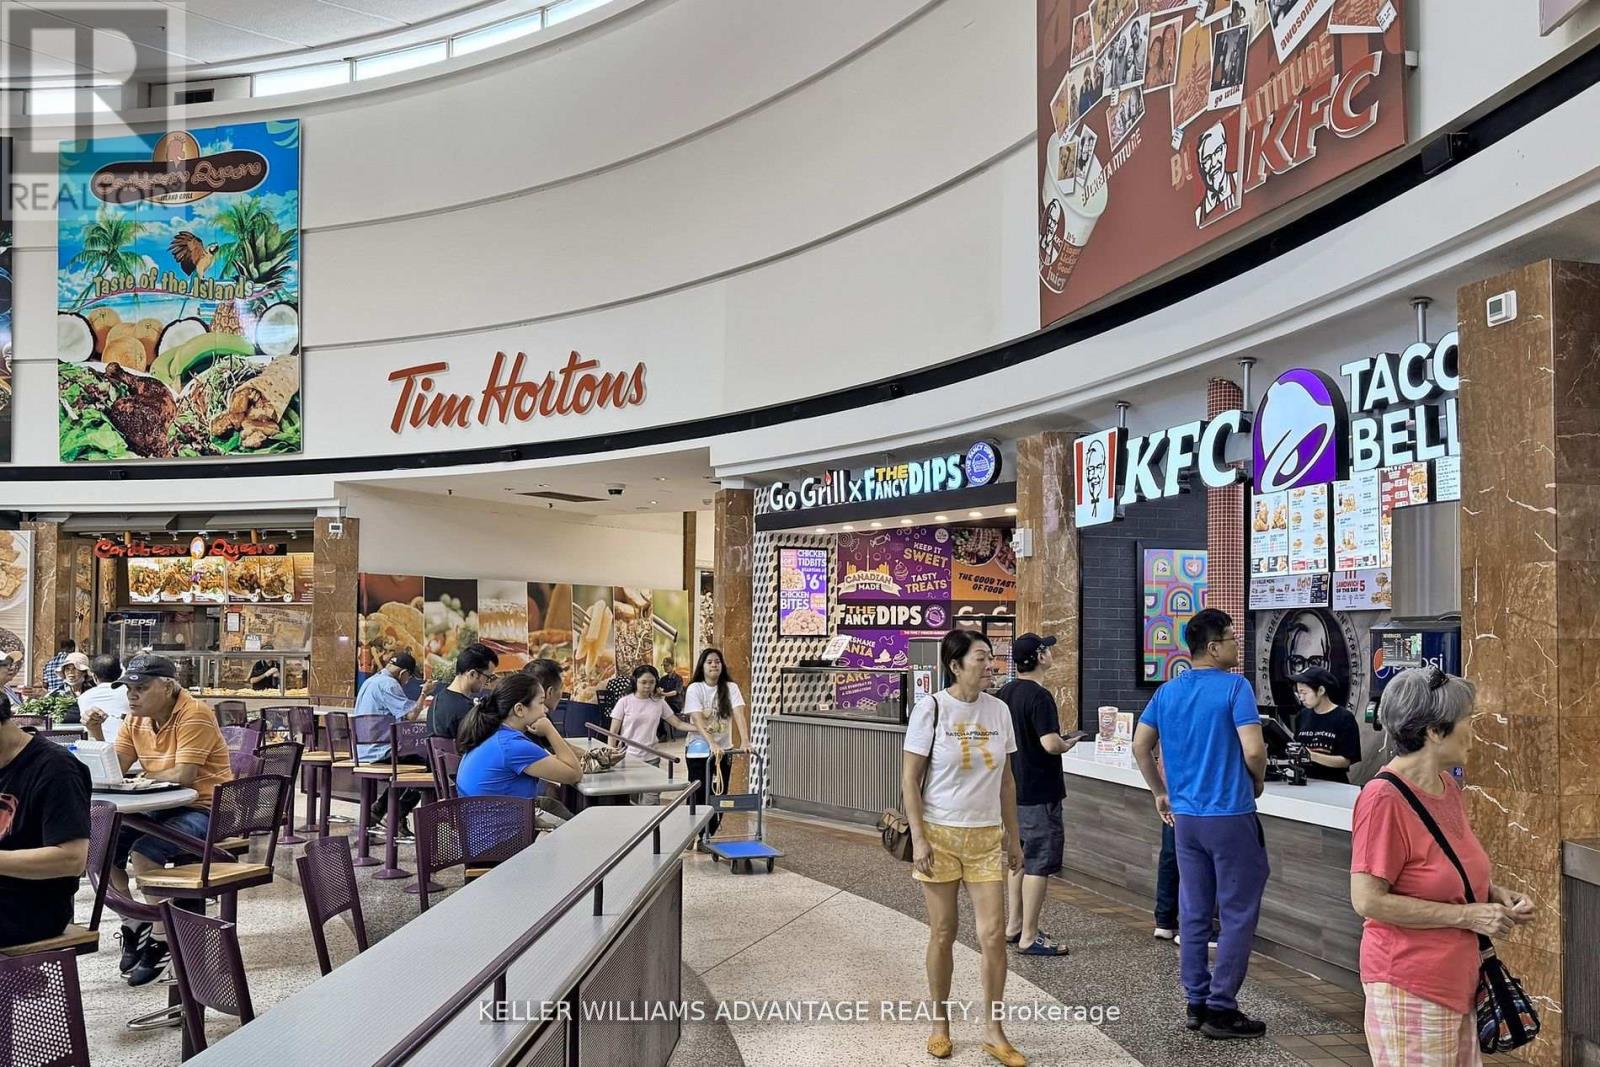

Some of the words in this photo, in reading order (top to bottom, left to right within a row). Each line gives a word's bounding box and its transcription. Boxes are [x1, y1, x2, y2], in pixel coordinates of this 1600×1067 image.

[1244, 51, 1383, 193] KFC
[191, 160, 262, 188] Queen
[93, 275, 135, 297] Taste
[139, 269, 158, 290] of
[161, 270, 188, 294] the
[192, 276, 254, 300] Islands
[1341, 331, 1459, 413] TACO
[388, 361, 474, 434] Tim
[478, 350, 646, 425] Hortons
[1119, 410, 1241, 505] KFC
[875, 464, 909, 481] THE
[908, 453, 962, 495] DIPS
[801, 470, 846, 507] Grill
[864, 467, 908, 501] FANCY
[770, 482, 796, 511] Go
[209, 538, 278, 563] Queen
[903, 548, 948, 568] SWEET
[913, 541, 933, 551] KEEP
[934, 546, 943, 554] IT
[797, 558, 827, 567] TIDBITS
[845, 572, 893, 585] CANADIAN
[905, 579, 948, 593] TREATS
[911, 572, 938, 582] TASTY
[958, 573, 973, 581] THE
[973, 575, 995, 584] GOOD
[996, 579, 1017, 589] TAST
[972, 583, 984, 591] OF
[984, 585, 1004, 594] FOOD
[780, 599, 810, 609] BITES
[836, 604, 876, 625] FANCY
[846, 605, 876, 614] THE
[124, 618, 157, 626] PEPSI
[876, 605, 922, 626] DIPS
[846, 643, 873, 658] ANIA
[1344, 627, 1359, 687] EXPERTS
